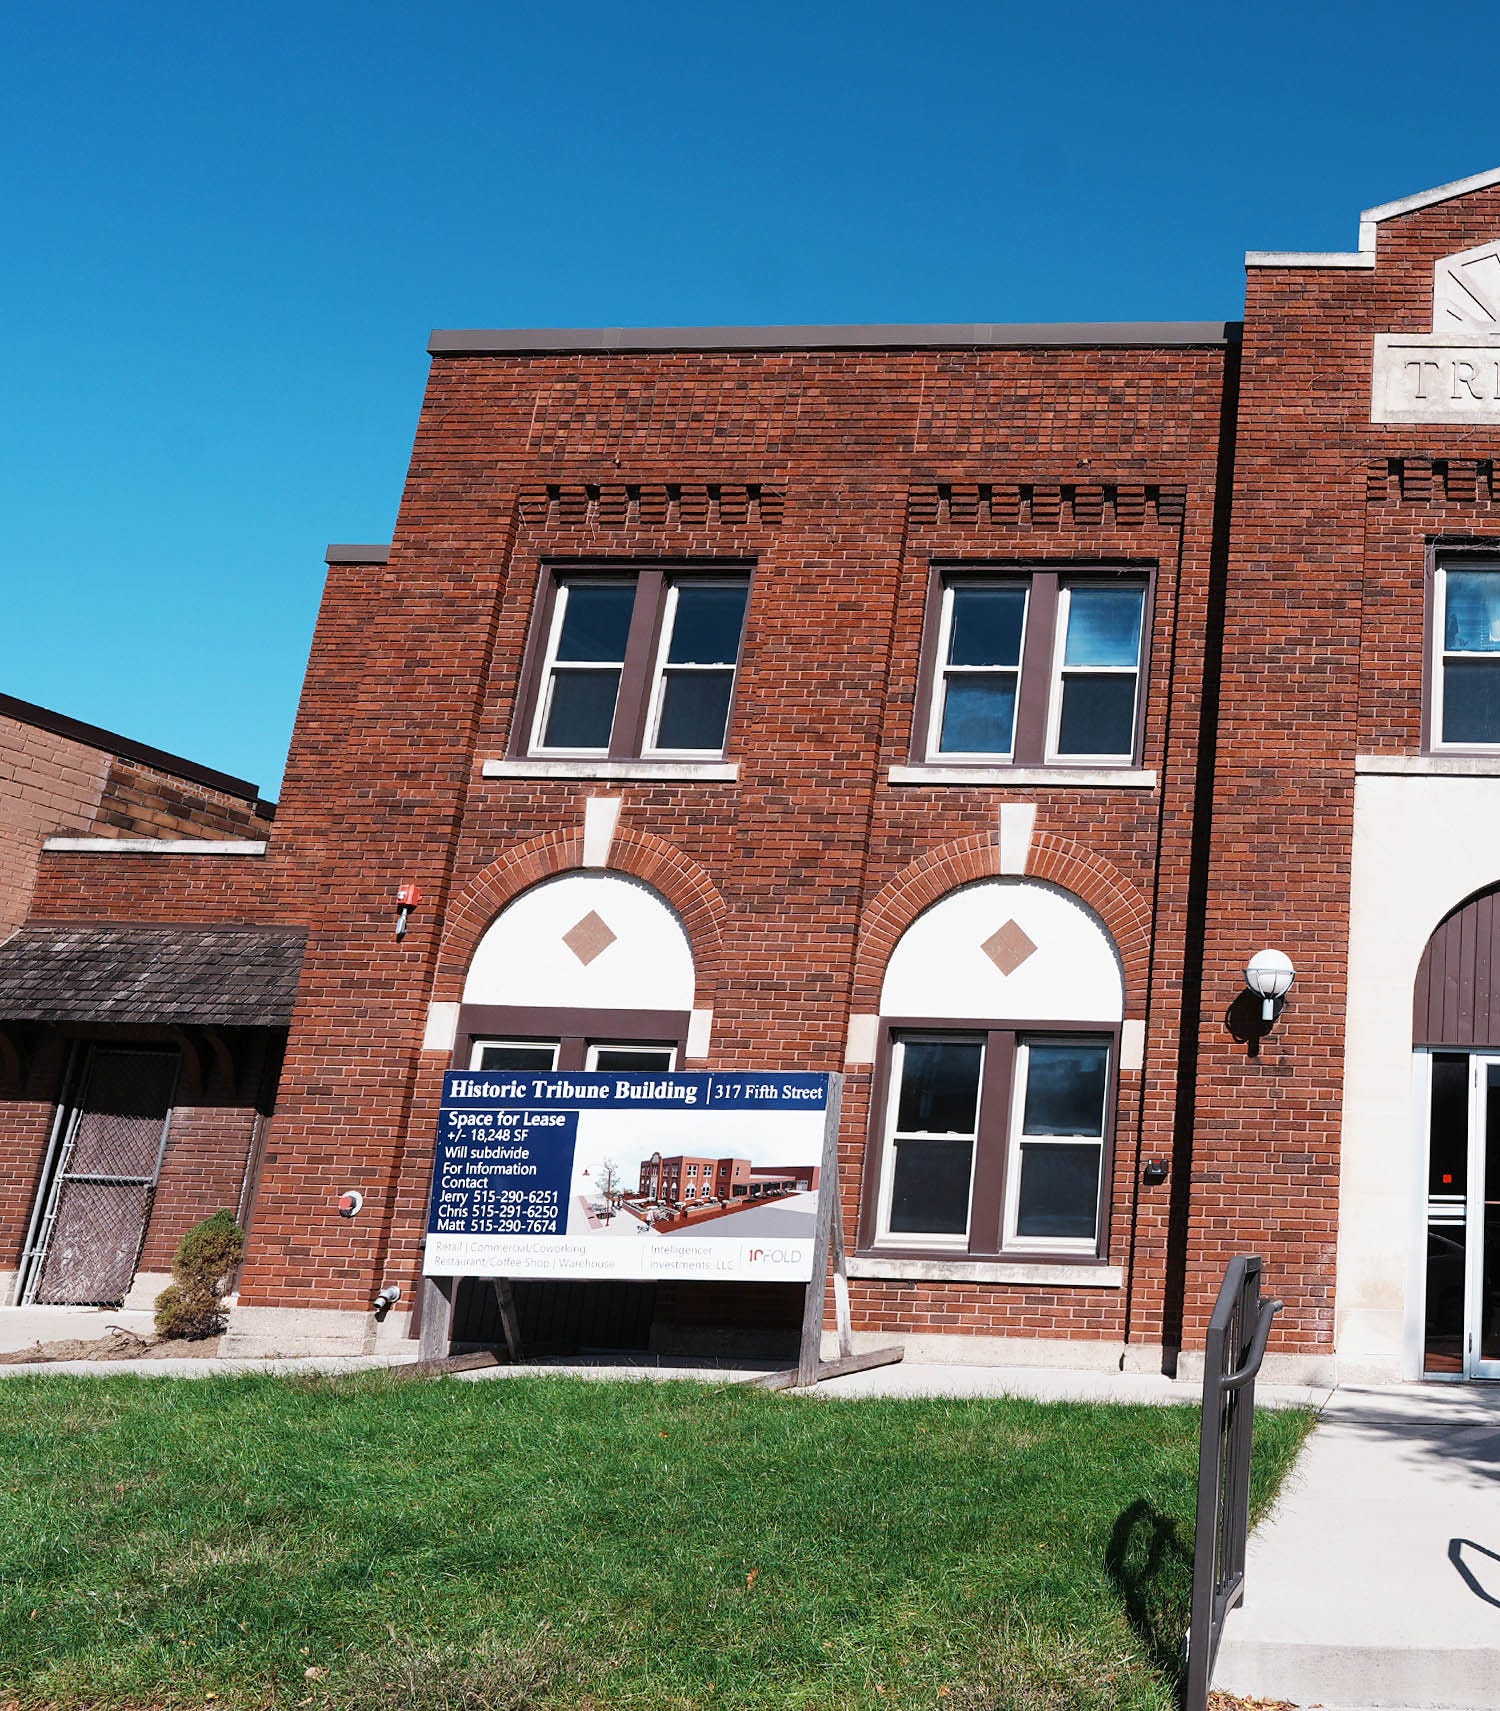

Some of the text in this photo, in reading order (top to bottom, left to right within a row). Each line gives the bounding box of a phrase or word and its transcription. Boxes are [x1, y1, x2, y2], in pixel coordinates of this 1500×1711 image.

[449, 1080, 698, 1103] Historic Tribune Building
[714, 1085, 823, 1099] 317 Fifth Street
[448, 1111, 566, 1129] Space for Lease
[447, 1129, 529, 1143] +/- 18,248 SF
[445, 1146, 530, 1159] Will subdivide
[443, 1162, 537, 1176] For Information
[441, 1176, 488, 1189] Contact
[439, 1190, 558, 1207] Jerry 515-290-6251
[438, 1205, 558, 1218] Chris 515-291-6250
[437, 1219, 557, 1233] Matt 515-290-7674
